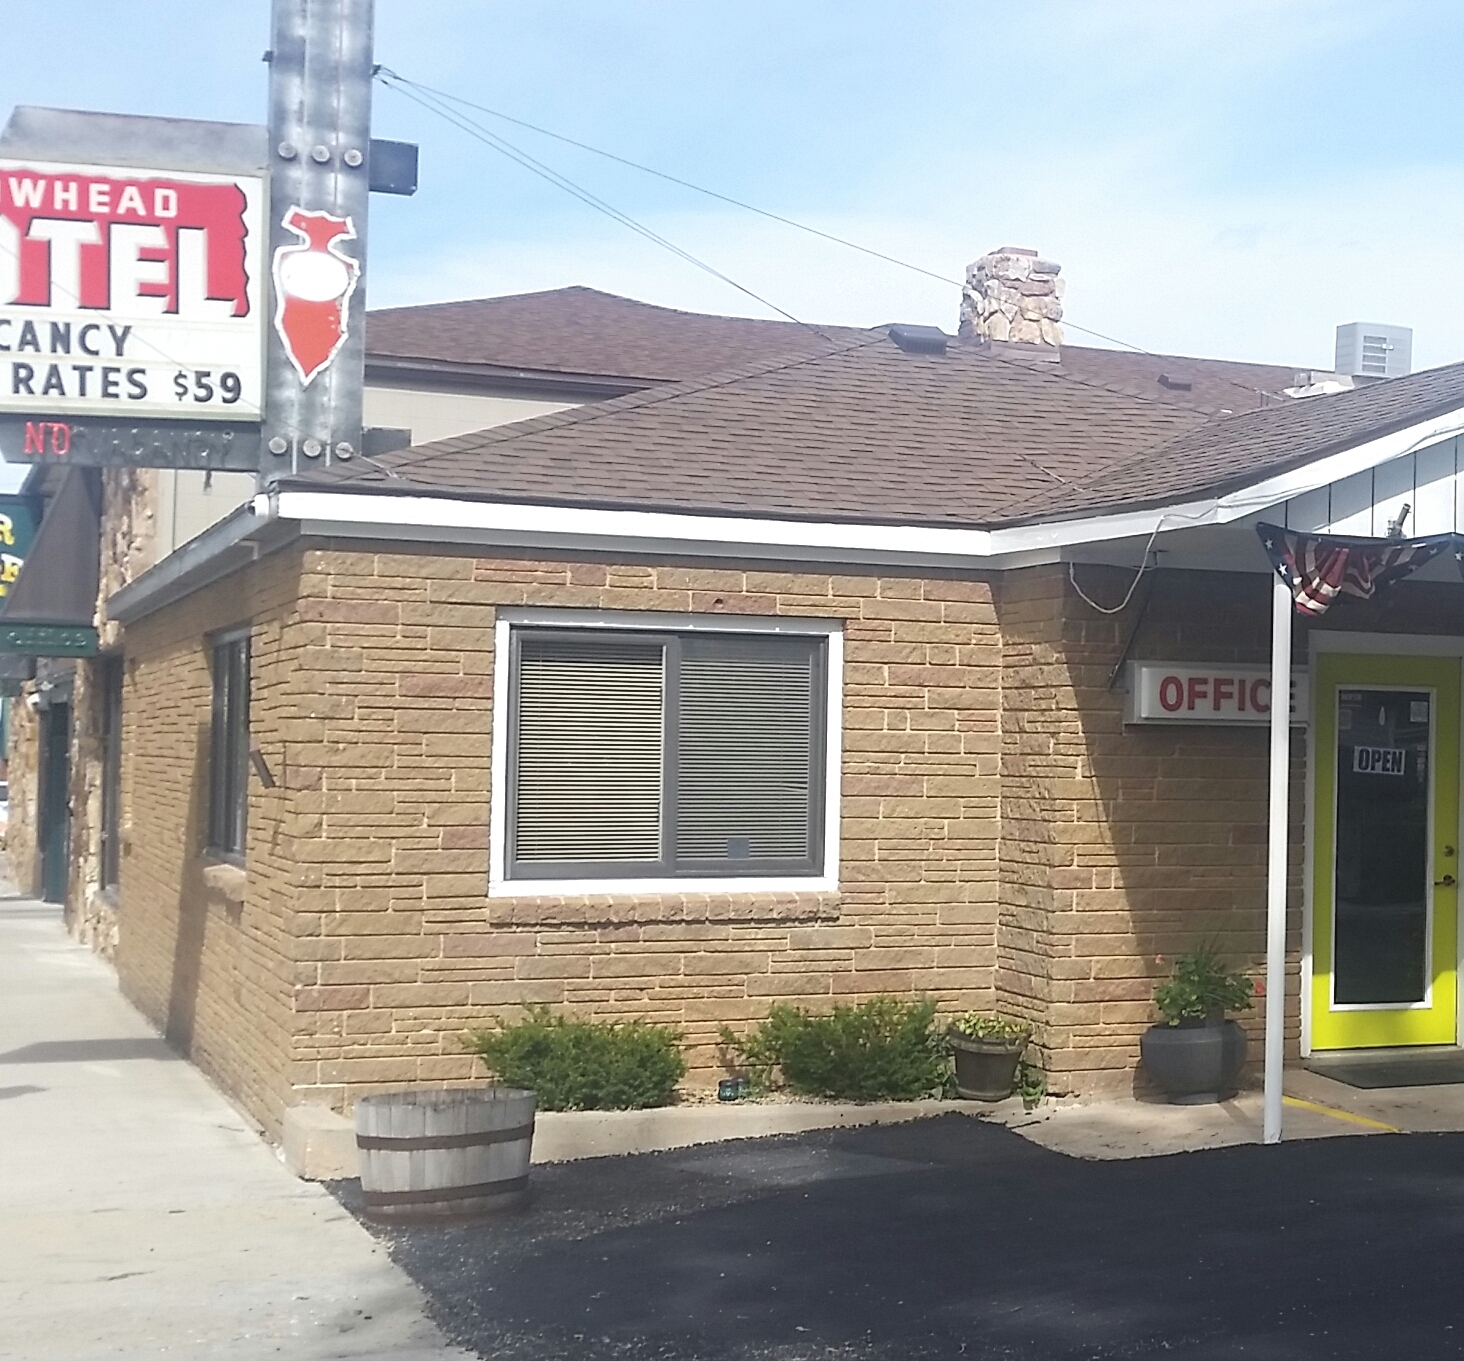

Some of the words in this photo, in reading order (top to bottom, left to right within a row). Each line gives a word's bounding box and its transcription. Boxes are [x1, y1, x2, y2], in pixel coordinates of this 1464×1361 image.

[12, 362, 148, 400] RATES
[173, 370, 242, 404] $59
[24, 421, 71, 455] NO
[1358, 747, 1403, 773] OPEN
